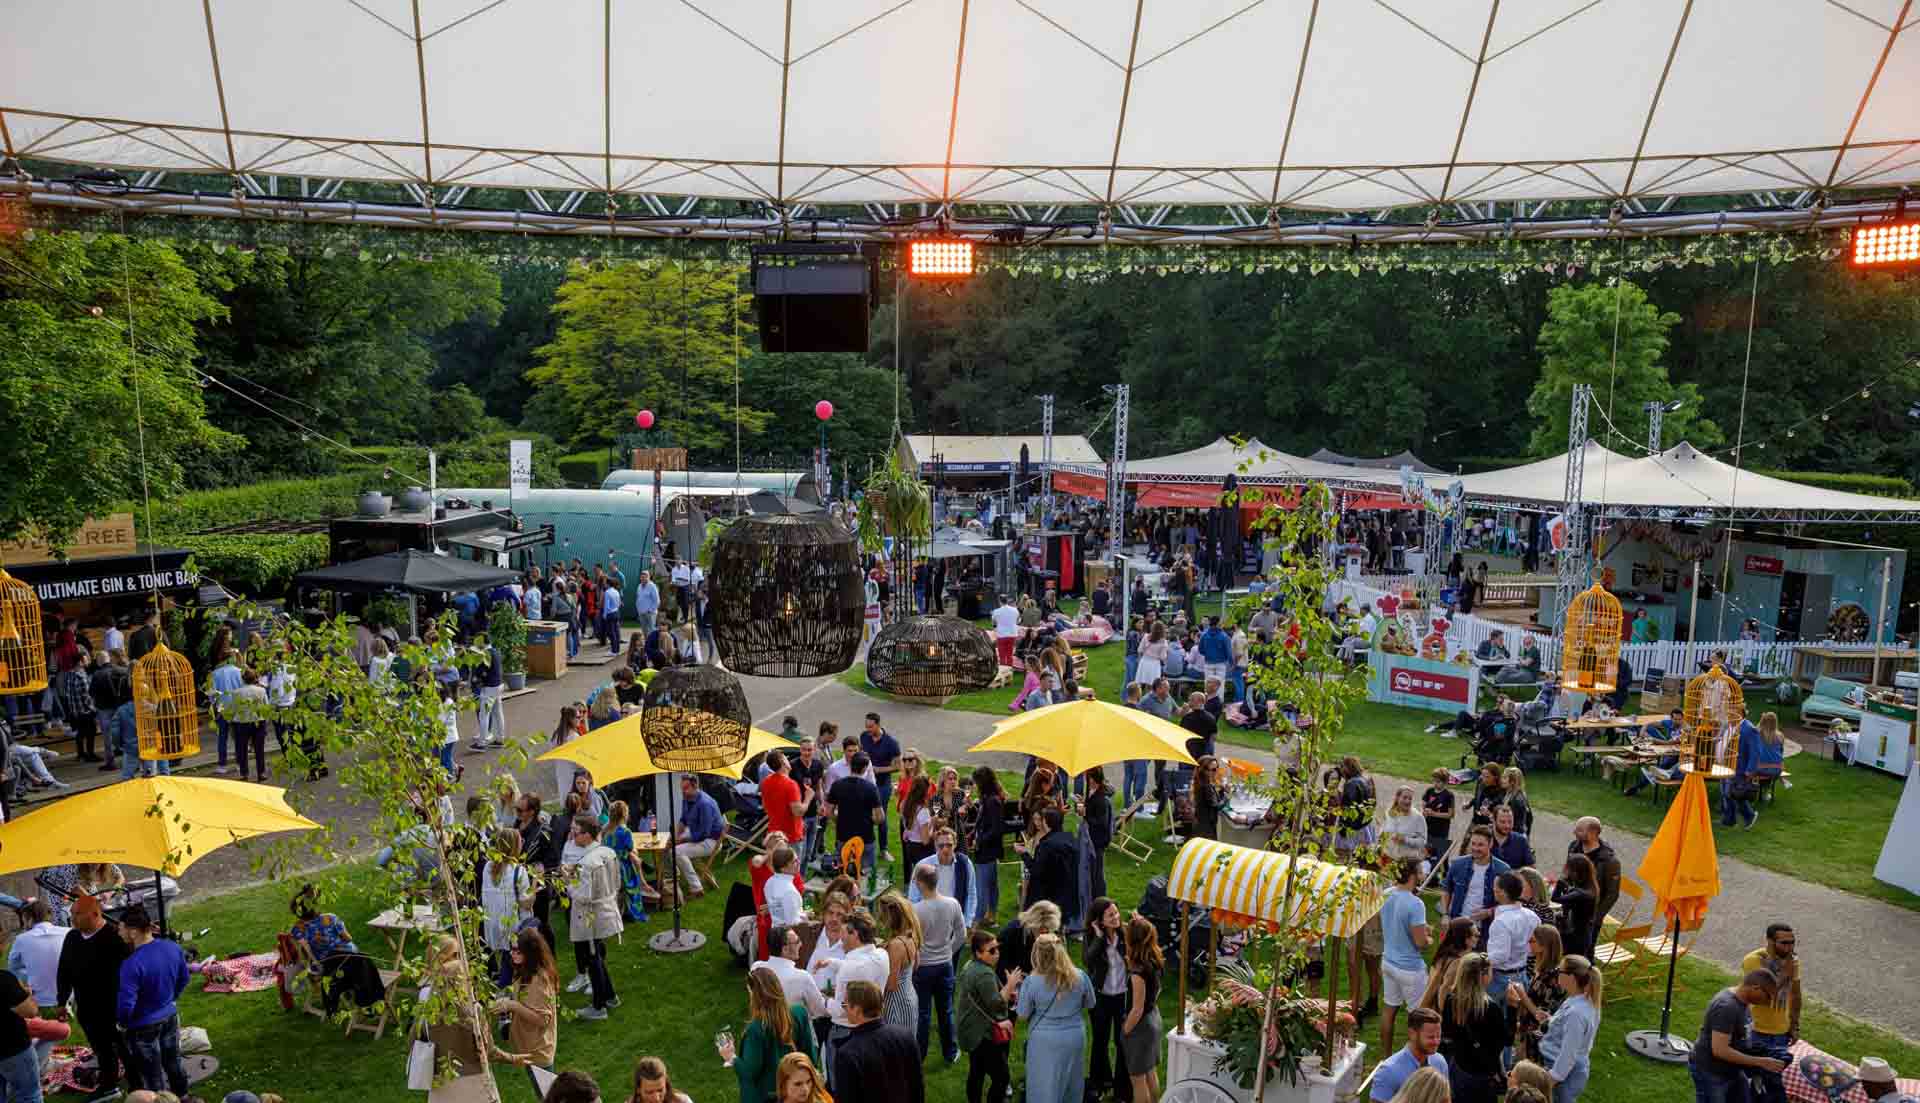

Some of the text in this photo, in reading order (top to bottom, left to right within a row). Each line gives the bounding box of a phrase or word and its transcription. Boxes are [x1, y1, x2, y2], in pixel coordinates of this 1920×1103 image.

[38, 578, 99, 600] ULTIMATE
[102, 576, 124, 593] GIN
[127, 576, 137, 591] &
[139, 571, 173, 590] TONIC
